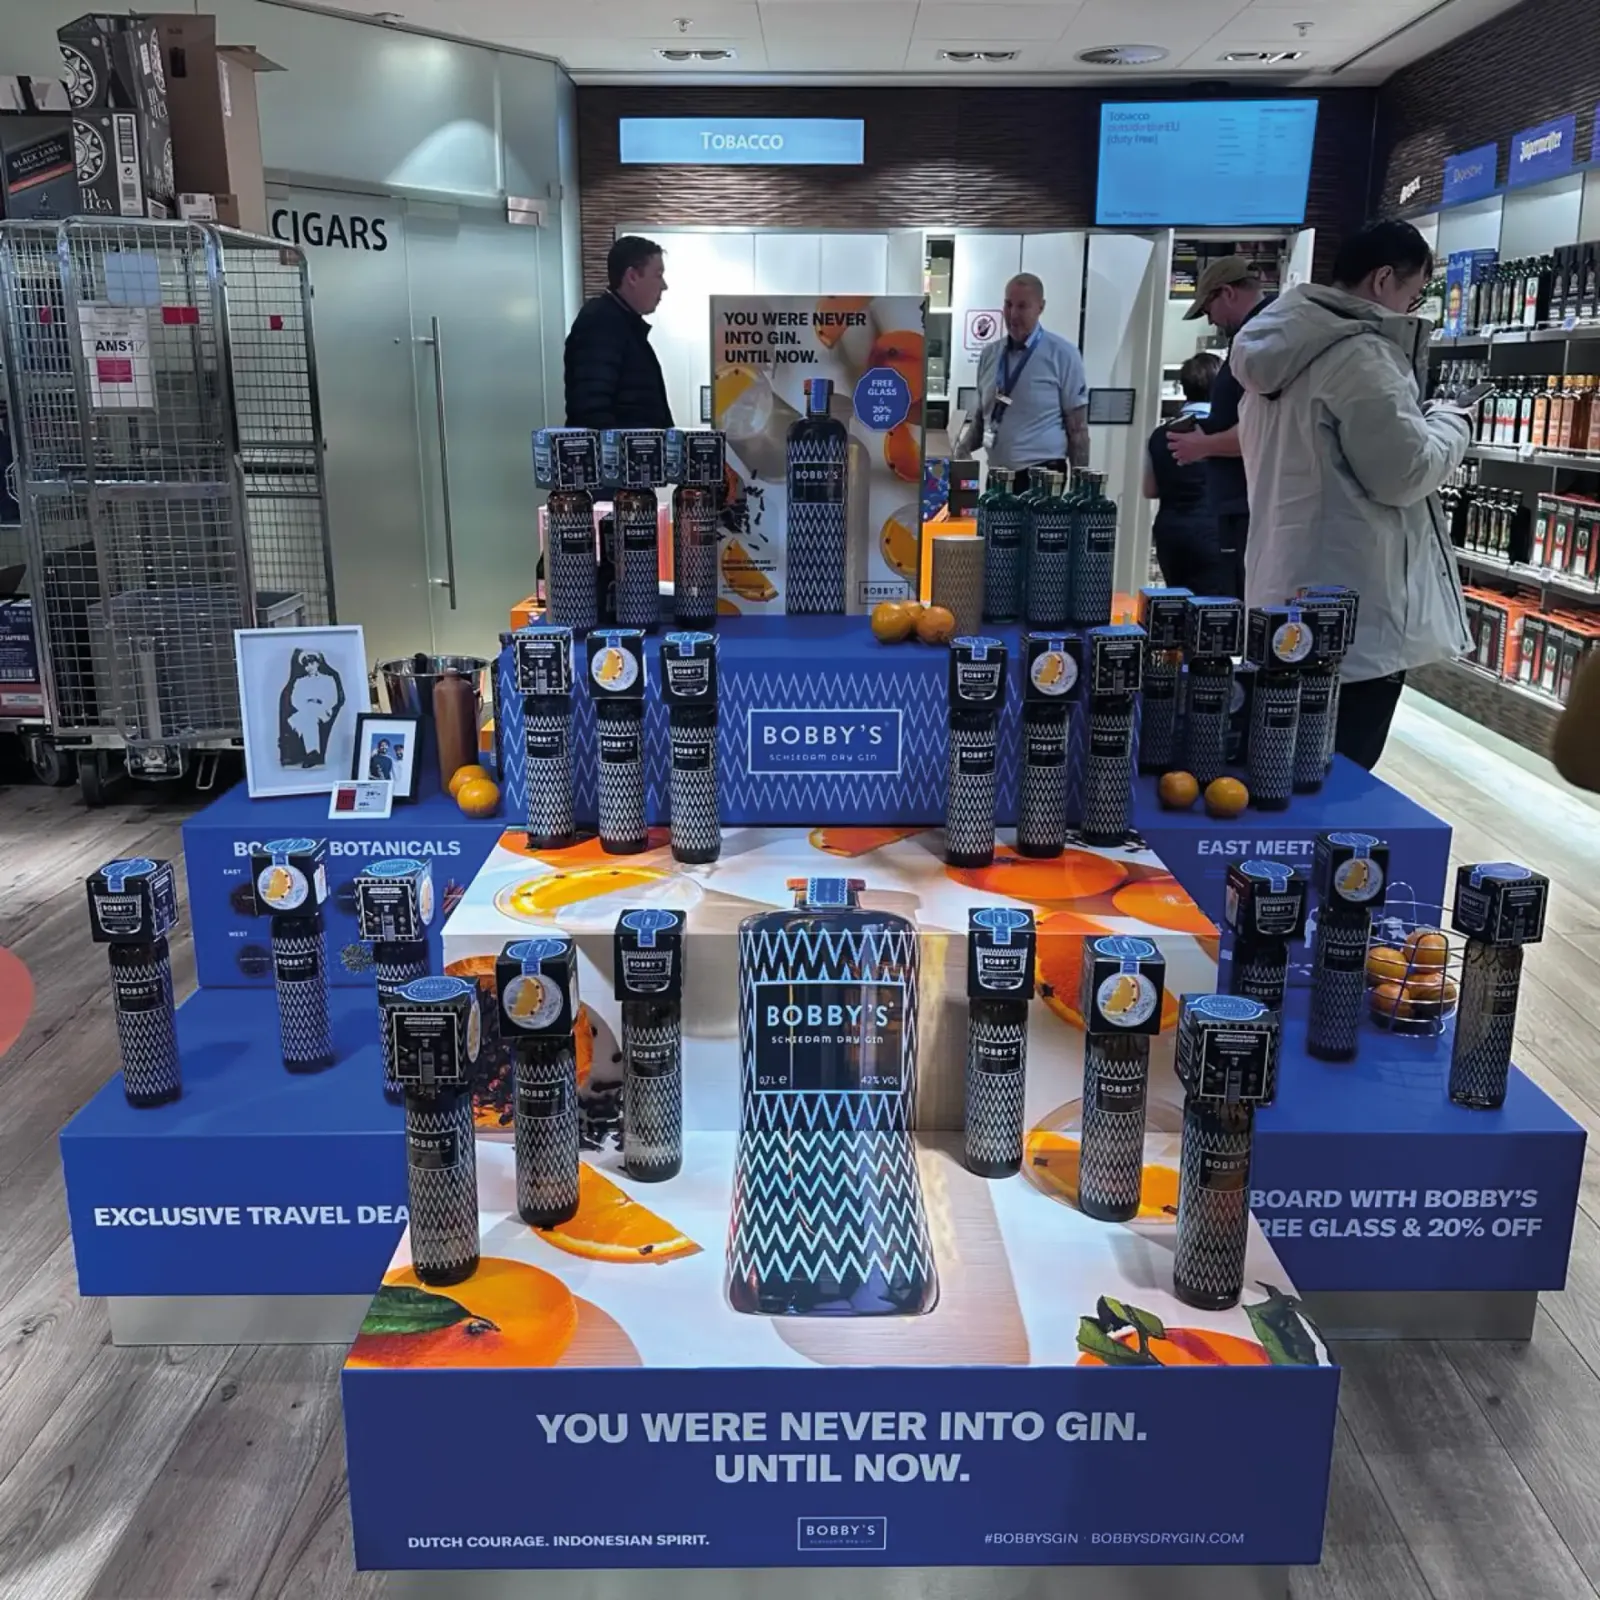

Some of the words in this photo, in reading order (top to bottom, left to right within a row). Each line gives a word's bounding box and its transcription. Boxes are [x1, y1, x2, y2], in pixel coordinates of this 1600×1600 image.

[700, 131, 784, 150] TOBACCO
[272, 209, 388, 252] CIGARS
[724, 312, 758, 326] YOU
[762, 312, 808, 326] WERE
[812, 312, 866, 326] NEVER
[724, 331, 763, 344] INTO
[767, 331, 801, 345] GIN.
[724, 350, 771, 363] UNTIL
[775, 350, 818, 363] NOW.
[871, 379, 894, 388] FREE
[867, 389, 897, 397] GLASS
[872, 405, 892, 414] 20%
[873, 414, 891, 423] OFF
[795, 469, 839, 480] BOBBY'S
[863, 587, 904, 596] BOBBY'S
[763, 725, 883, 745] BOBBY'S
[769, 753, 826, 761] SCHIEDAM
[831, 753, 852, 761] DRY
[857, 753, 877, 761] GIN
[329, 840, 461, 856] BOTANICALS
[1197, 840, 1250, 855] EAST
[767, 1004, 889, 1027] BOBBY'S
[771, 1036, 832, 1044] SCHIEDAM
[836, 1036, 860, 1044] DRY
[865, 1036, 884, 1044] GIN
[409, 1137, 452, 1148] BOBBY'S
[1250, 1190, 1342, 1208] BOARD
[1350, 1190, 1417, 1208] WITH
[1424, 1190, 1538, 1208] BOBBY'S
[94, 1207, 241, 1226] EXCLUSIVE
[247, 1207, 350, 1225] TRAVEL
[358, 1206, 409, 1224] DEA
[1259, 1218, 1303, 1237] REE
[1309, 1218, 1397, 1237] GLASS
[1402, 1218, 1421, 1237] &
[1428, 1218, 1485, 1237] 20%
[1492, 1218, 1543, 1237] OFF
[537, 1412, 629, 1443] YOU
[641, 1412, 767, 1443] WERE
[780, 1411, 926, 1441] NEVER
[940, 1411, 1045, 1441] INTO
[1055, 1411, 1148, 1441] GIN.
[715, 1454, 842, 1483] UNTIL
[855, 1453, 970, 1482] NOW.
[806, 1525, 876, 1536] BOBBY'S
[408, 1537, 462, 1548] DUTCH
[467, 1536, 549, 1548] COURAGE.
[553, 1535, 652, 1546] INDONESIAN
[656, 1534, 710, 1546] SPIRIT.
[984, 1533, 1079, 1544] #BOBBYSGIN
[1091, 1533, 1245, 1544] BOBBYSDRYGIN.COM
